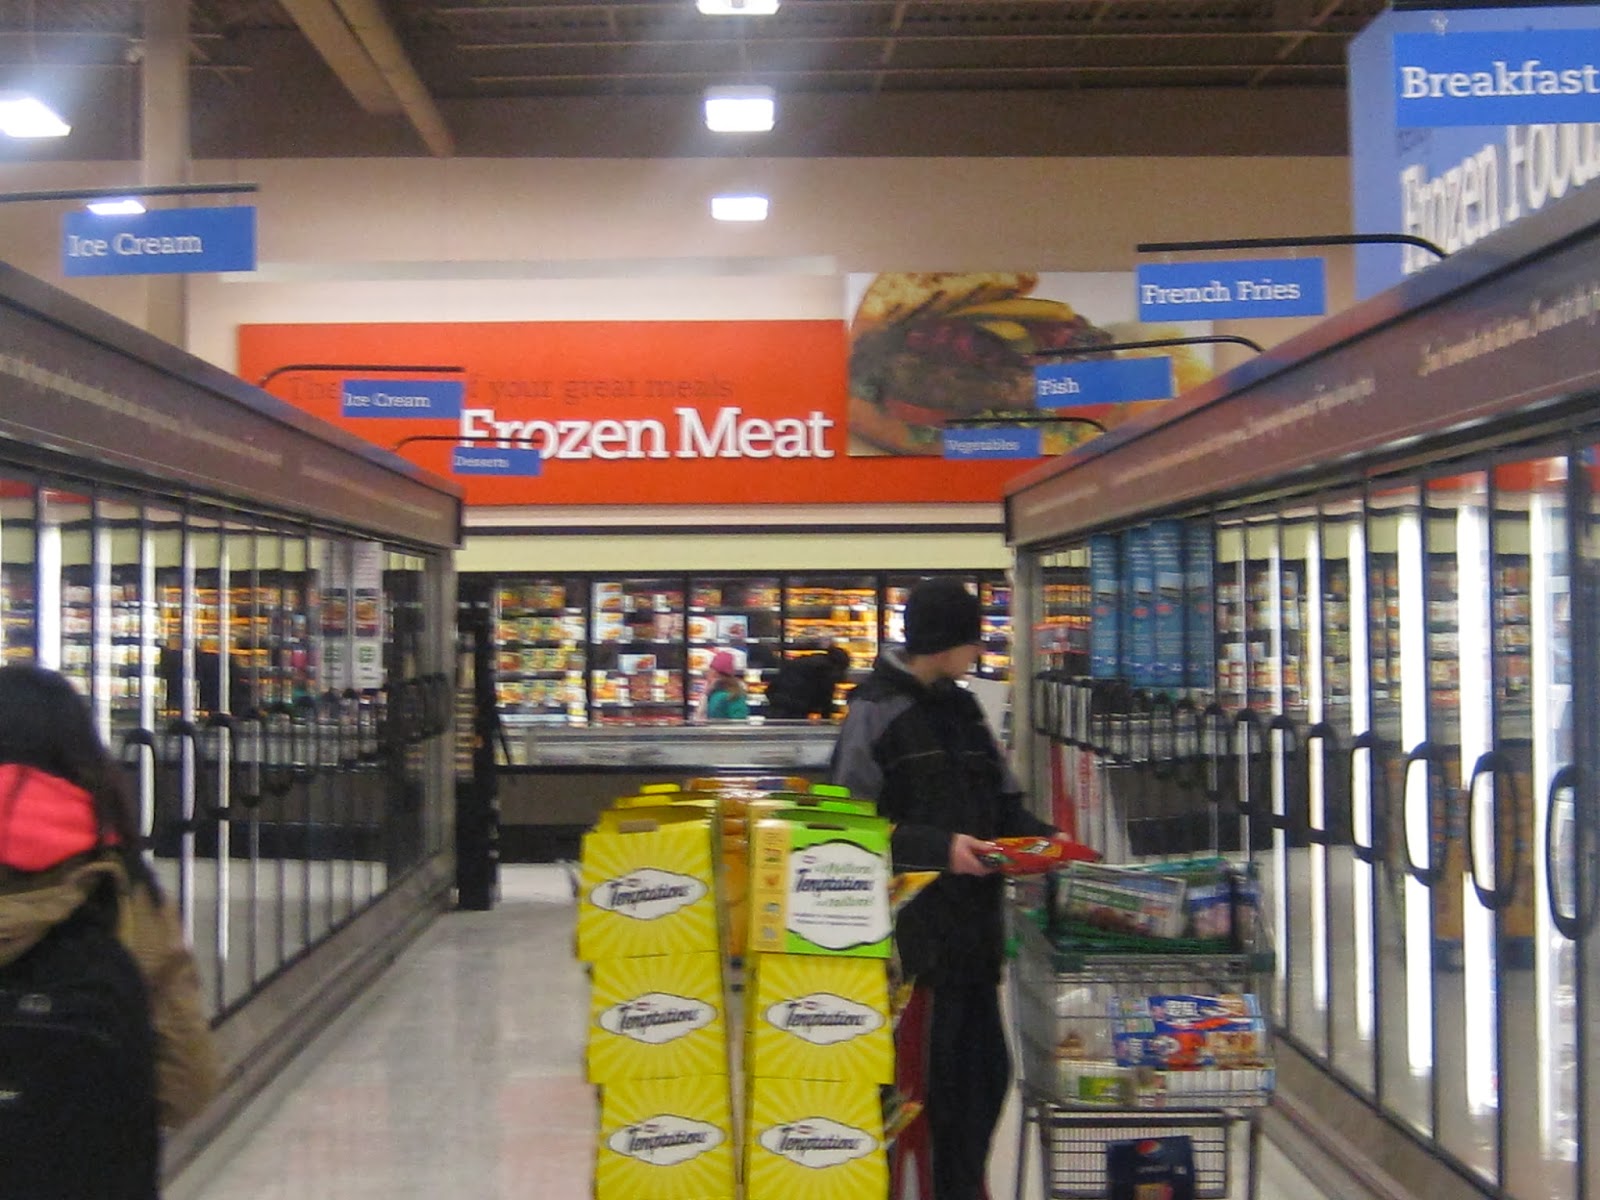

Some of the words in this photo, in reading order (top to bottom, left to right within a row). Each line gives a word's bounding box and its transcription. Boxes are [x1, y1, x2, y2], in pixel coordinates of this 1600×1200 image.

[1401, 59, 1600, 100] Breakfast
[68, 234, 108, 257] Ice
[113, 232, 203, 256] Cream
[1141, 280, 1231, 305] French
[1236, 278, 1301, 302] Fries
[1037, 377, 1080, 396] Fish
[344, 392, 370, 408] Ice
[372, 393, 430, 408] Cream
[460, 407, 670, 459] Frozen
[674, 406, 835, 458] Meat
